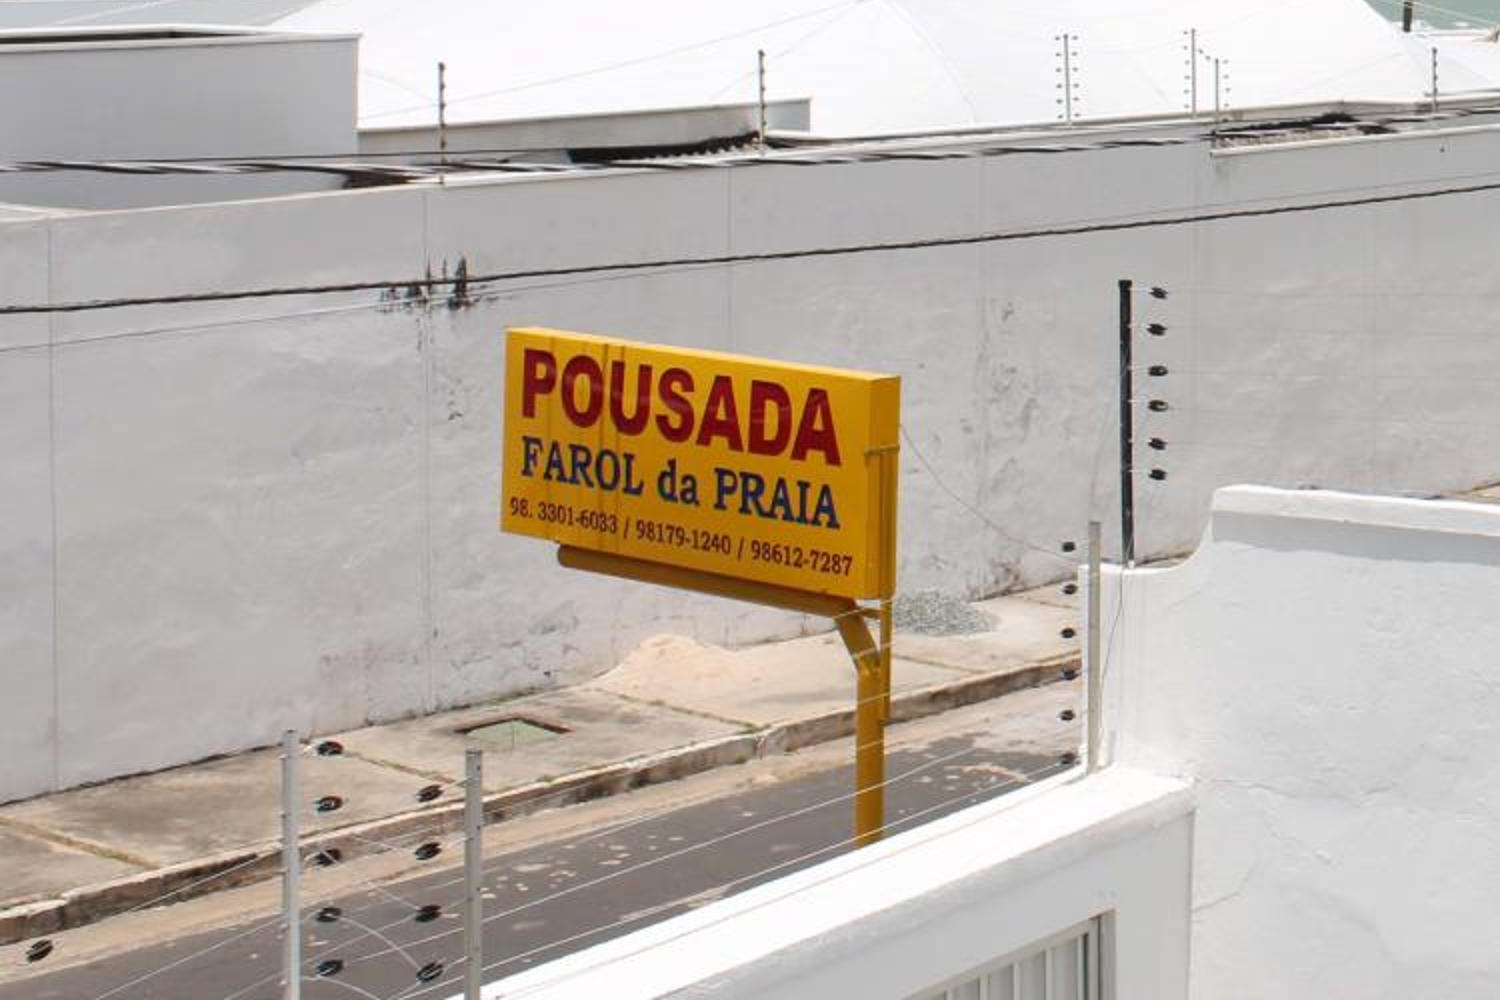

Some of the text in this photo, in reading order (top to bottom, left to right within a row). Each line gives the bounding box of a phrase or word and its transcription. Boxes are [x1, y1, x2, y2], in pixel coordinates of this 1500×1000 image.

[521, 348, 842, 466] POUSADA
[521, 436, 841, 530] FAROL da PRAIA
[510, 497, 534, 518] 98.
[537, 502, 619, 535] 3301-6033
[635, 519, 732, 556] 98179-1240
[751, 539, 853, 577] 98612-7287
